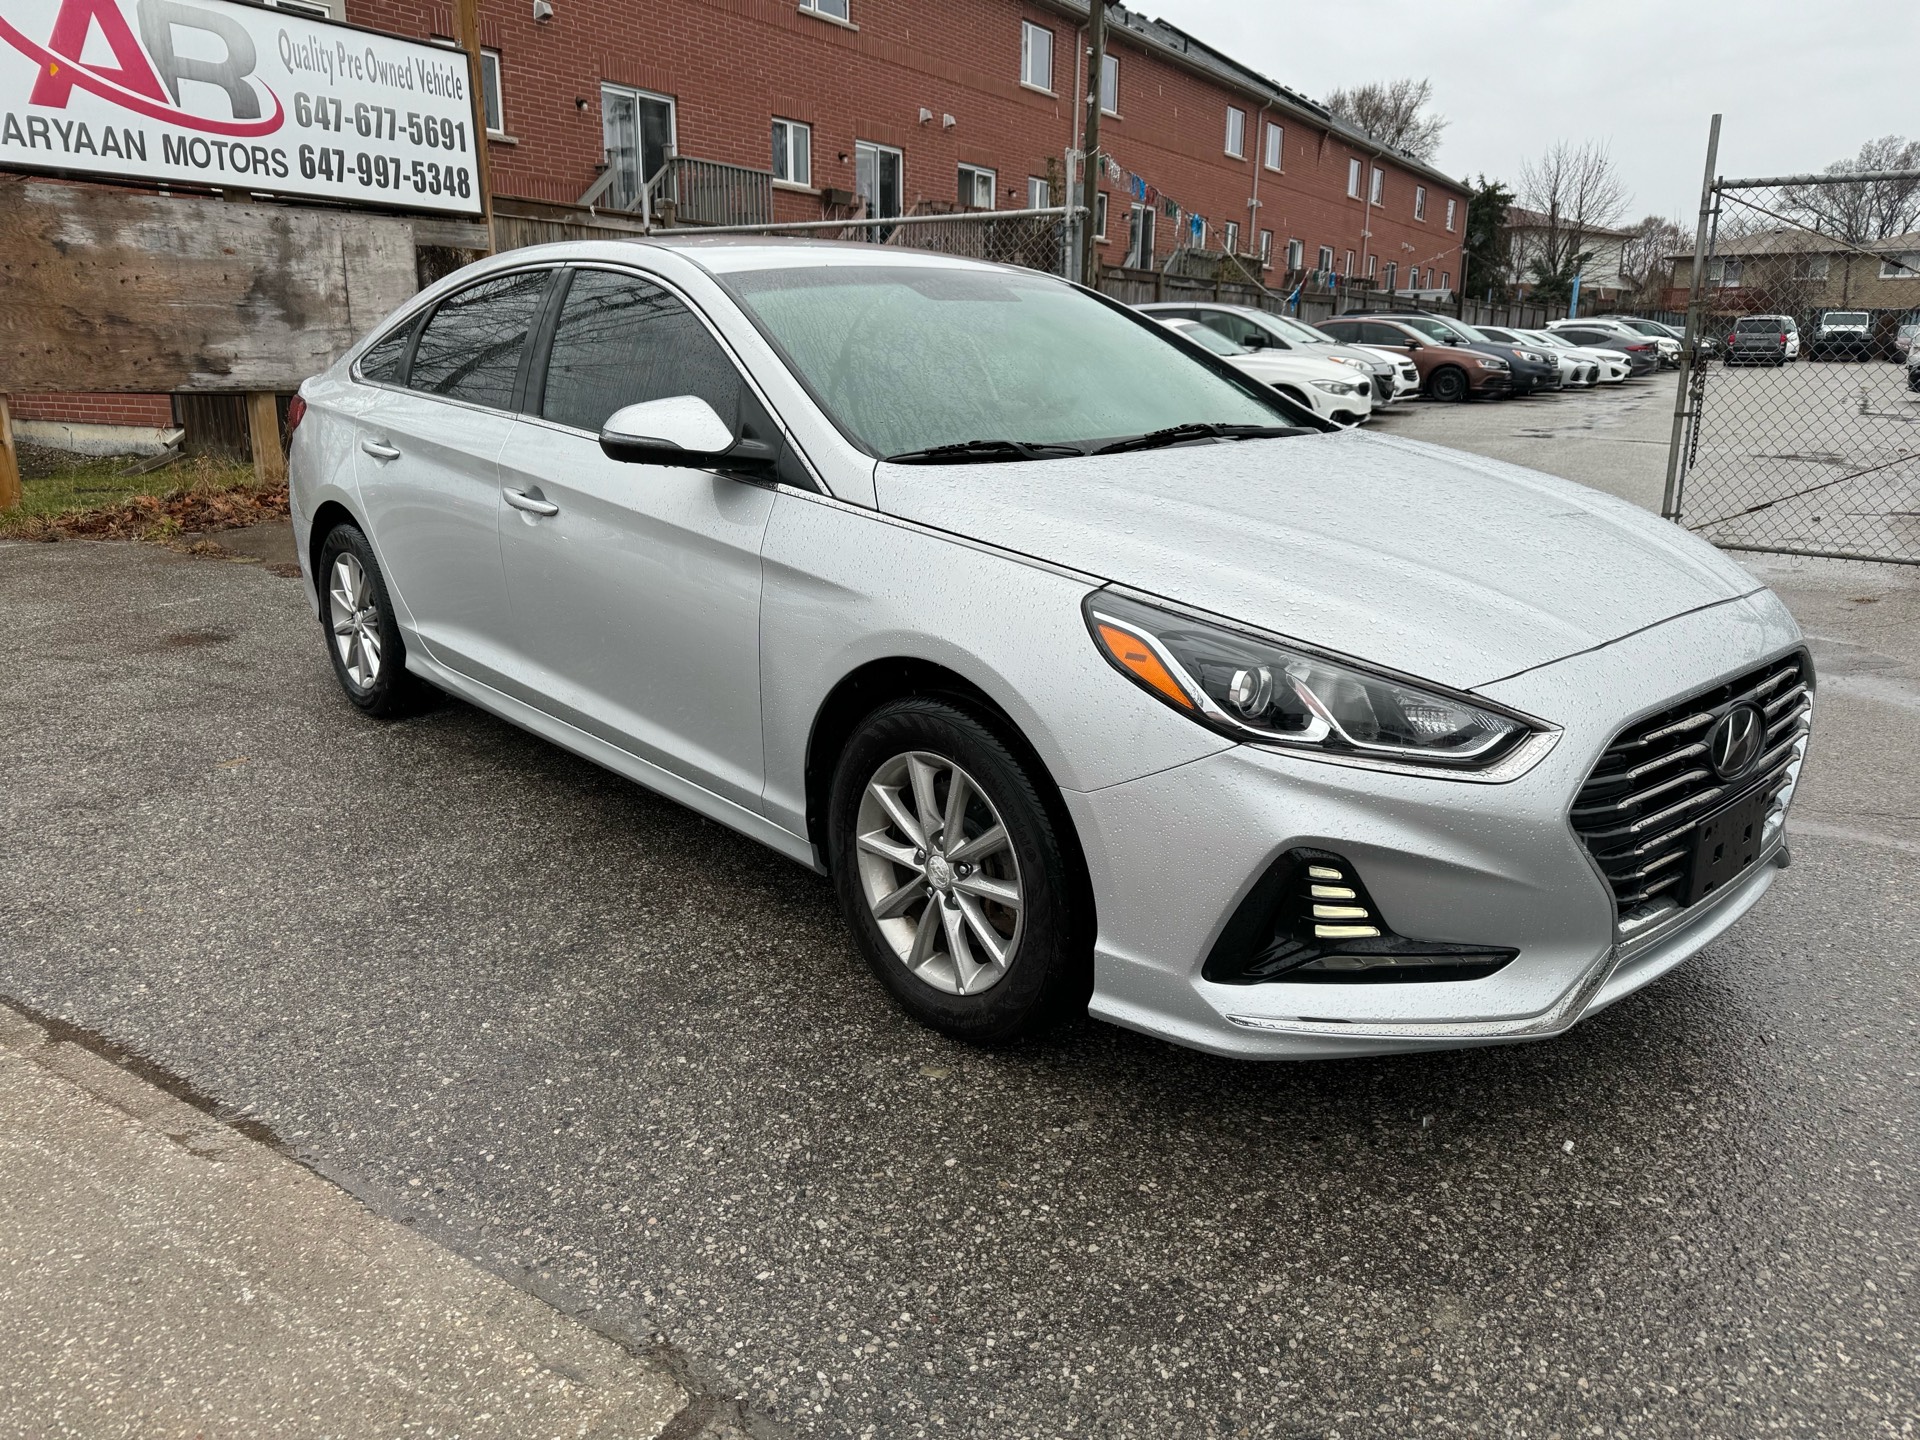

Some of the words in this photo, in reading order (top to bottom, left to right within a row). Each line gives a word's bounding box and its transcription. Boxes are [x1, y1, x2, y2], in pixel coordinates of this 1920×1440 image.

[277, 27, 334, 86] Quality
[335, 40, 363, 81] Pre
[364, 47, 414, 91] Owned
[415, 57, 463, 101] Vehicle
[1, 112, 147, 162] ARYAAN
[162, 133, 289, 178] MOTORS
[293, 91, 467, 152] 647-677-5691
[298, 143, 471, 199] 647-997-5348
